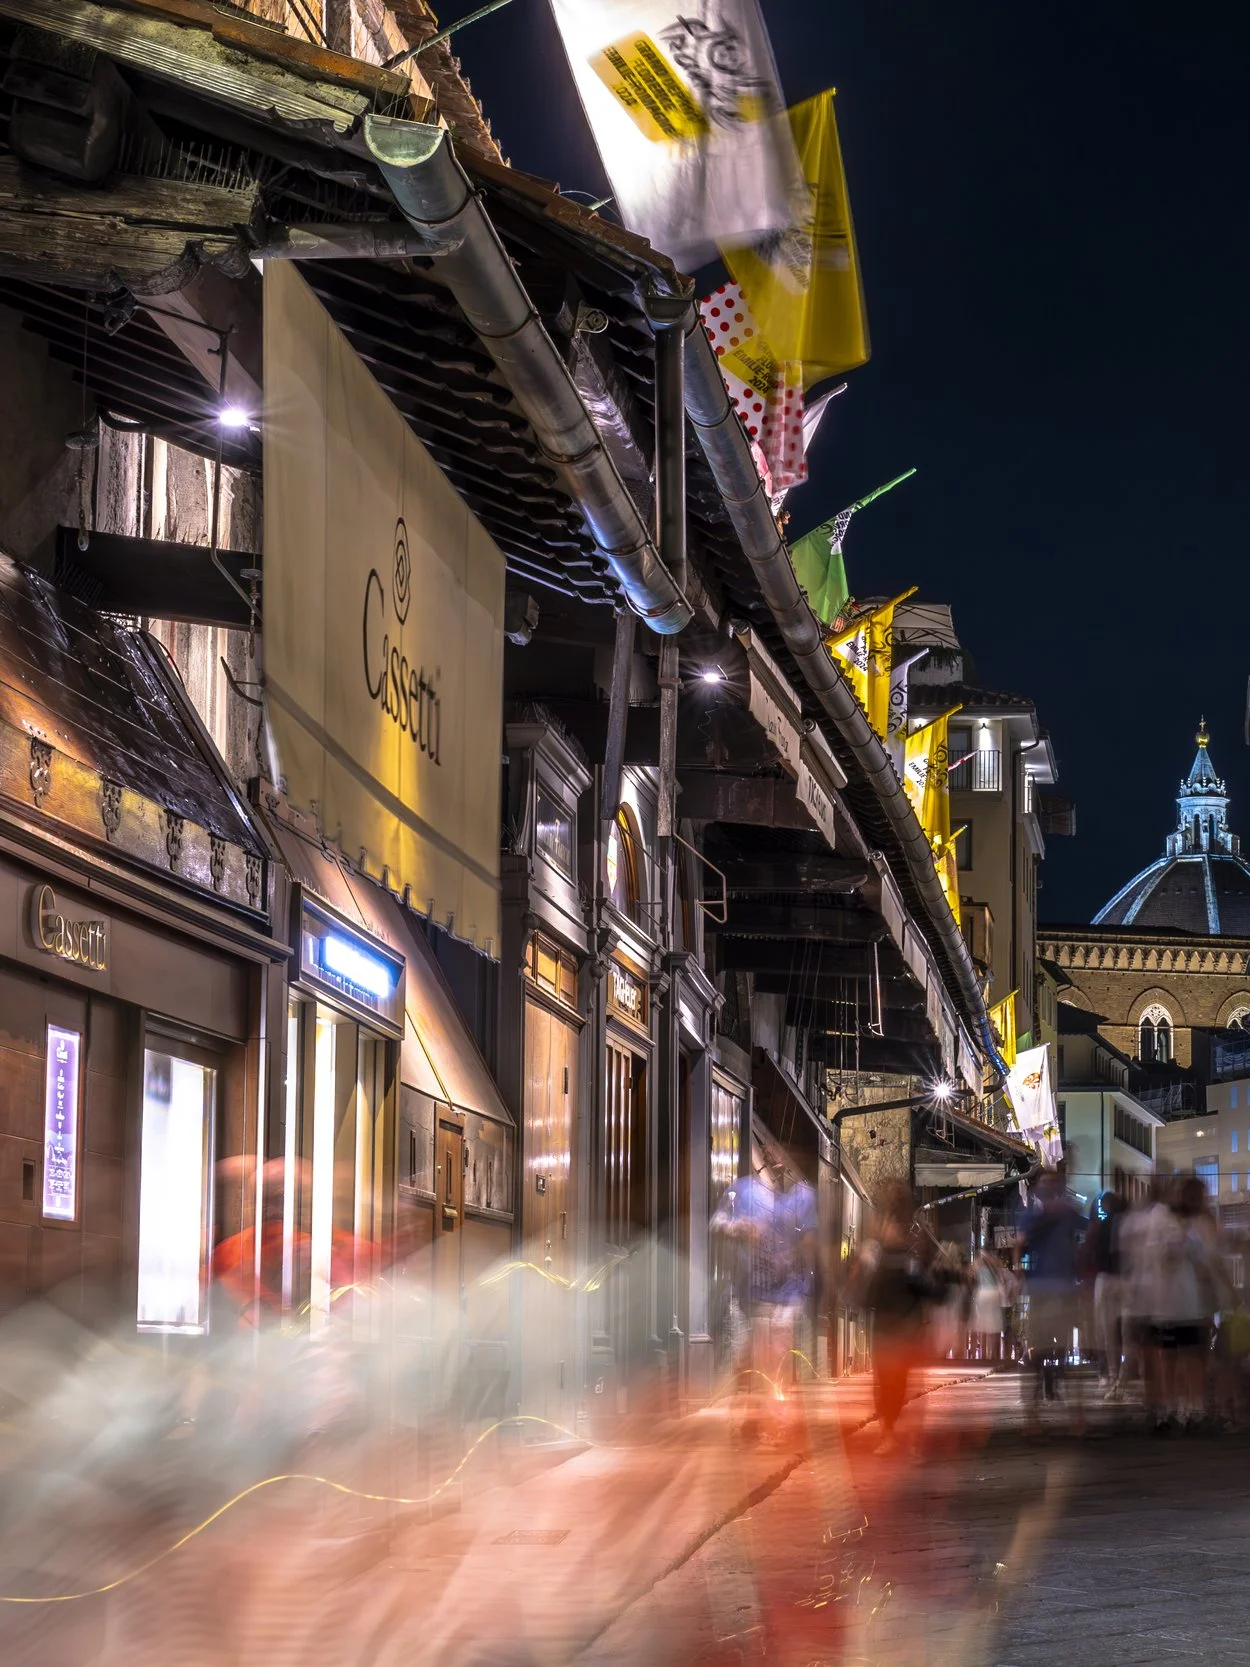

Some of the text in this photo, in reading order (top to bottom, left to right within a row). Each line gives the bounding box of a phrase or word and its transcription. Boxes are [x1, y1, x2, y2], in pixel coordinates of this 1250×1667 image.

[747, 373, 771, 396] 2024
[363, 568, 441, 767] Cassetti
[852, 656, 869, 673] 2024
[38, 885, 107, 971] Cassetti
